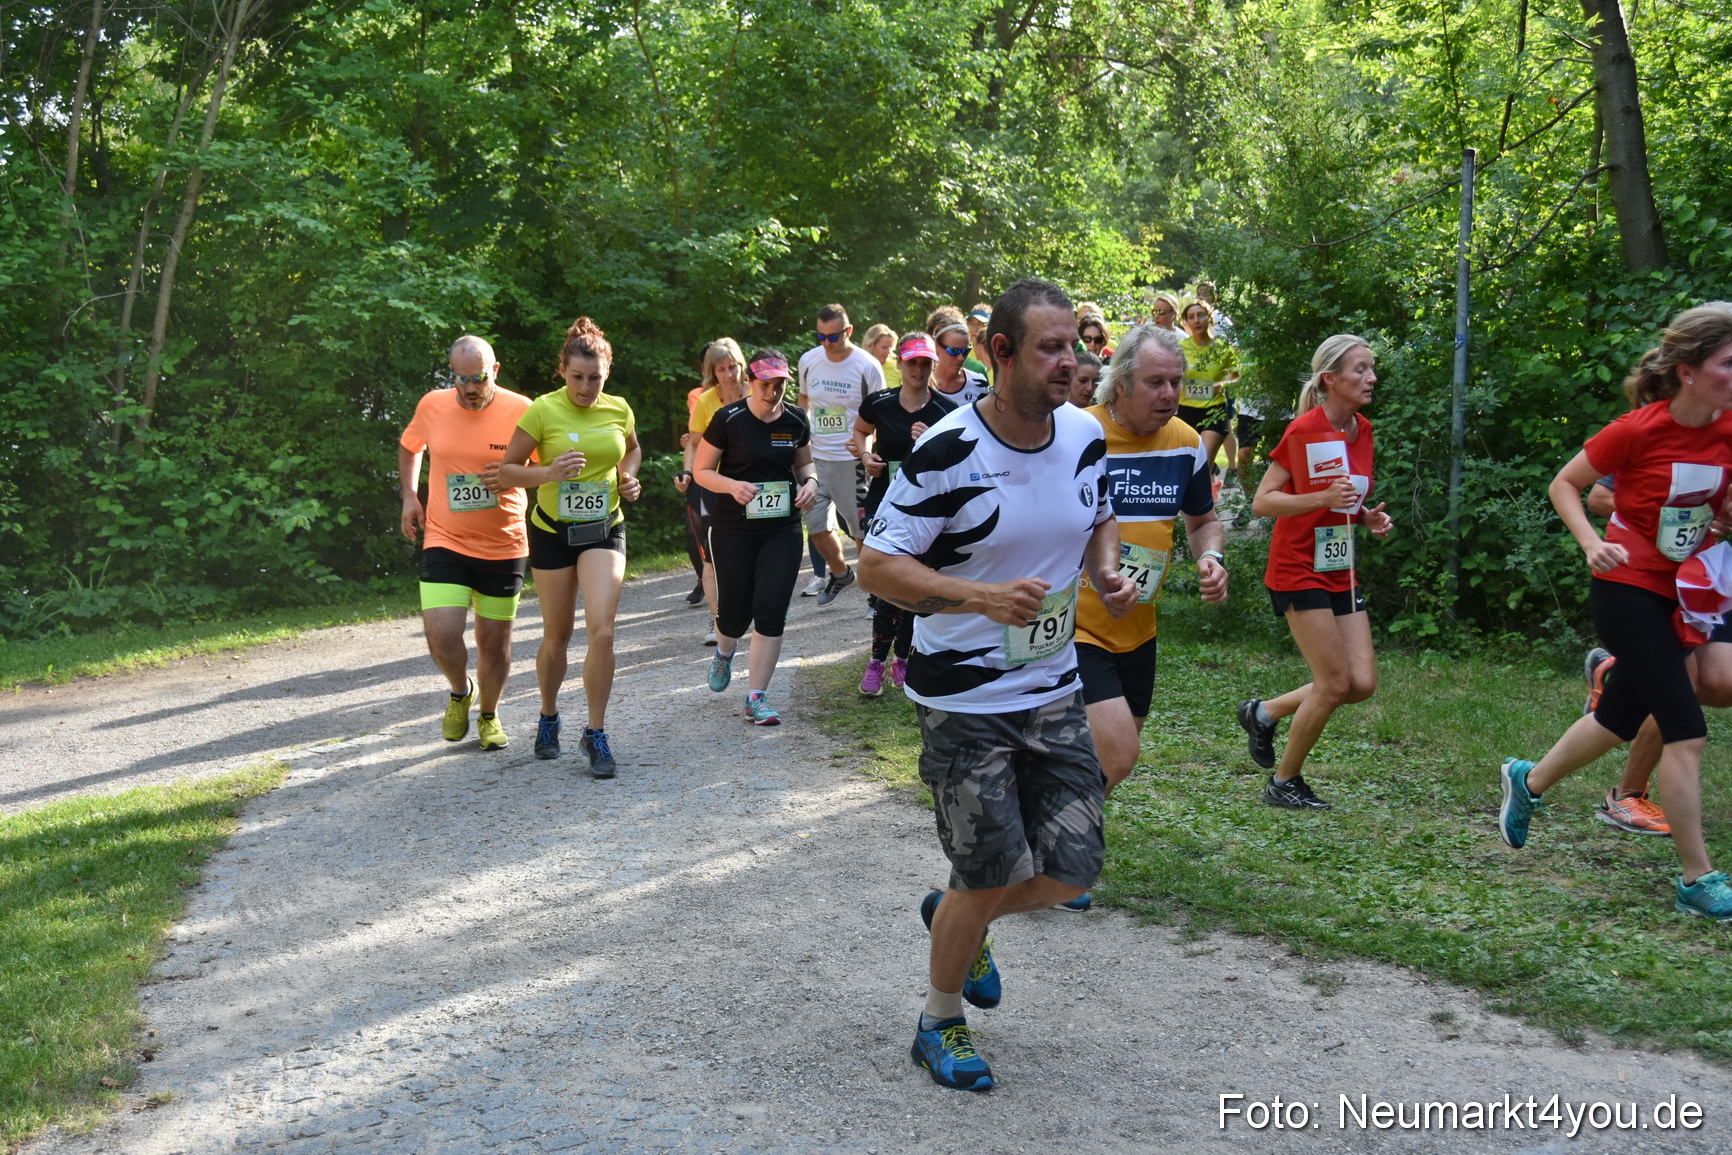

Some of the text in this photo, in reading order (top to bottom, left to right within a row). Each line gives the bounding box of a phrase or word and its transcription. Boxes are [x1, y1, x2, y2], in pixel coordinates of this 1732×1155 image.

[824, 386, 847, 394] TREPPEN
[1187, 386, 1209, 395] 1231
[817, 416, 842, 427] 1003
[452, 486, 490, 501] 2301
[1113, 481, 1179, 496] Fischer
[564, 495, 604, 510] 1265
[756, 494, 781, 508] 127
[1324, 541, 1347, 559] 530
[1027, 608, 1069, 644] 797
[1029, 640, 1055, 651] Prucker
